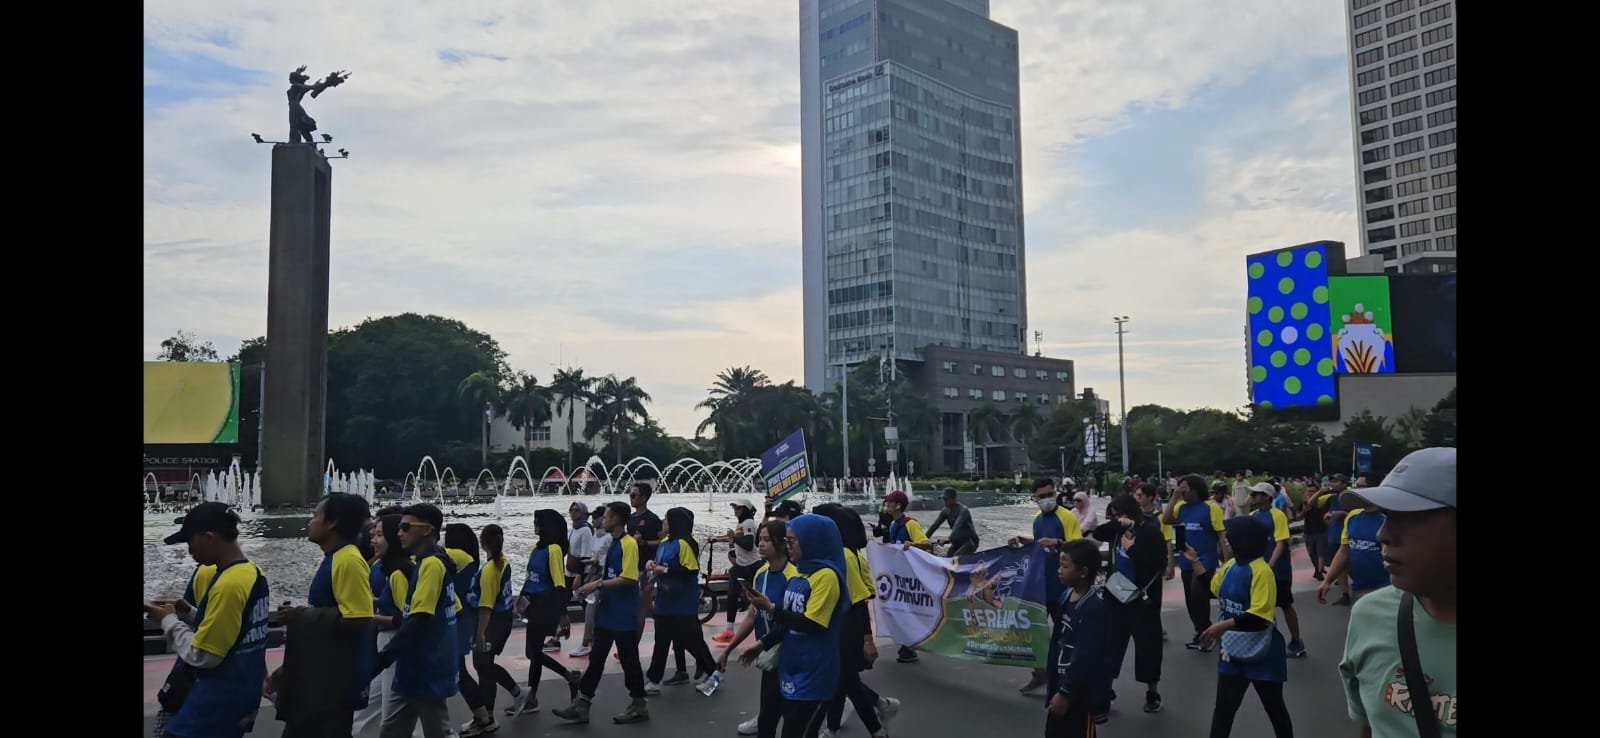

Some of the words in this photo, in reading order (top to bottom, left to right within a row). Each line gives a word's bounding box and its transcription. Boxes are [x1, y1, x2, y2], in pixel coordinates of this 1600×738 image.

[143, 457, 180, 465] POLICE
[182, 457, 219, 465] STATION
[962, 608, 1031, 630] PERLUAS
